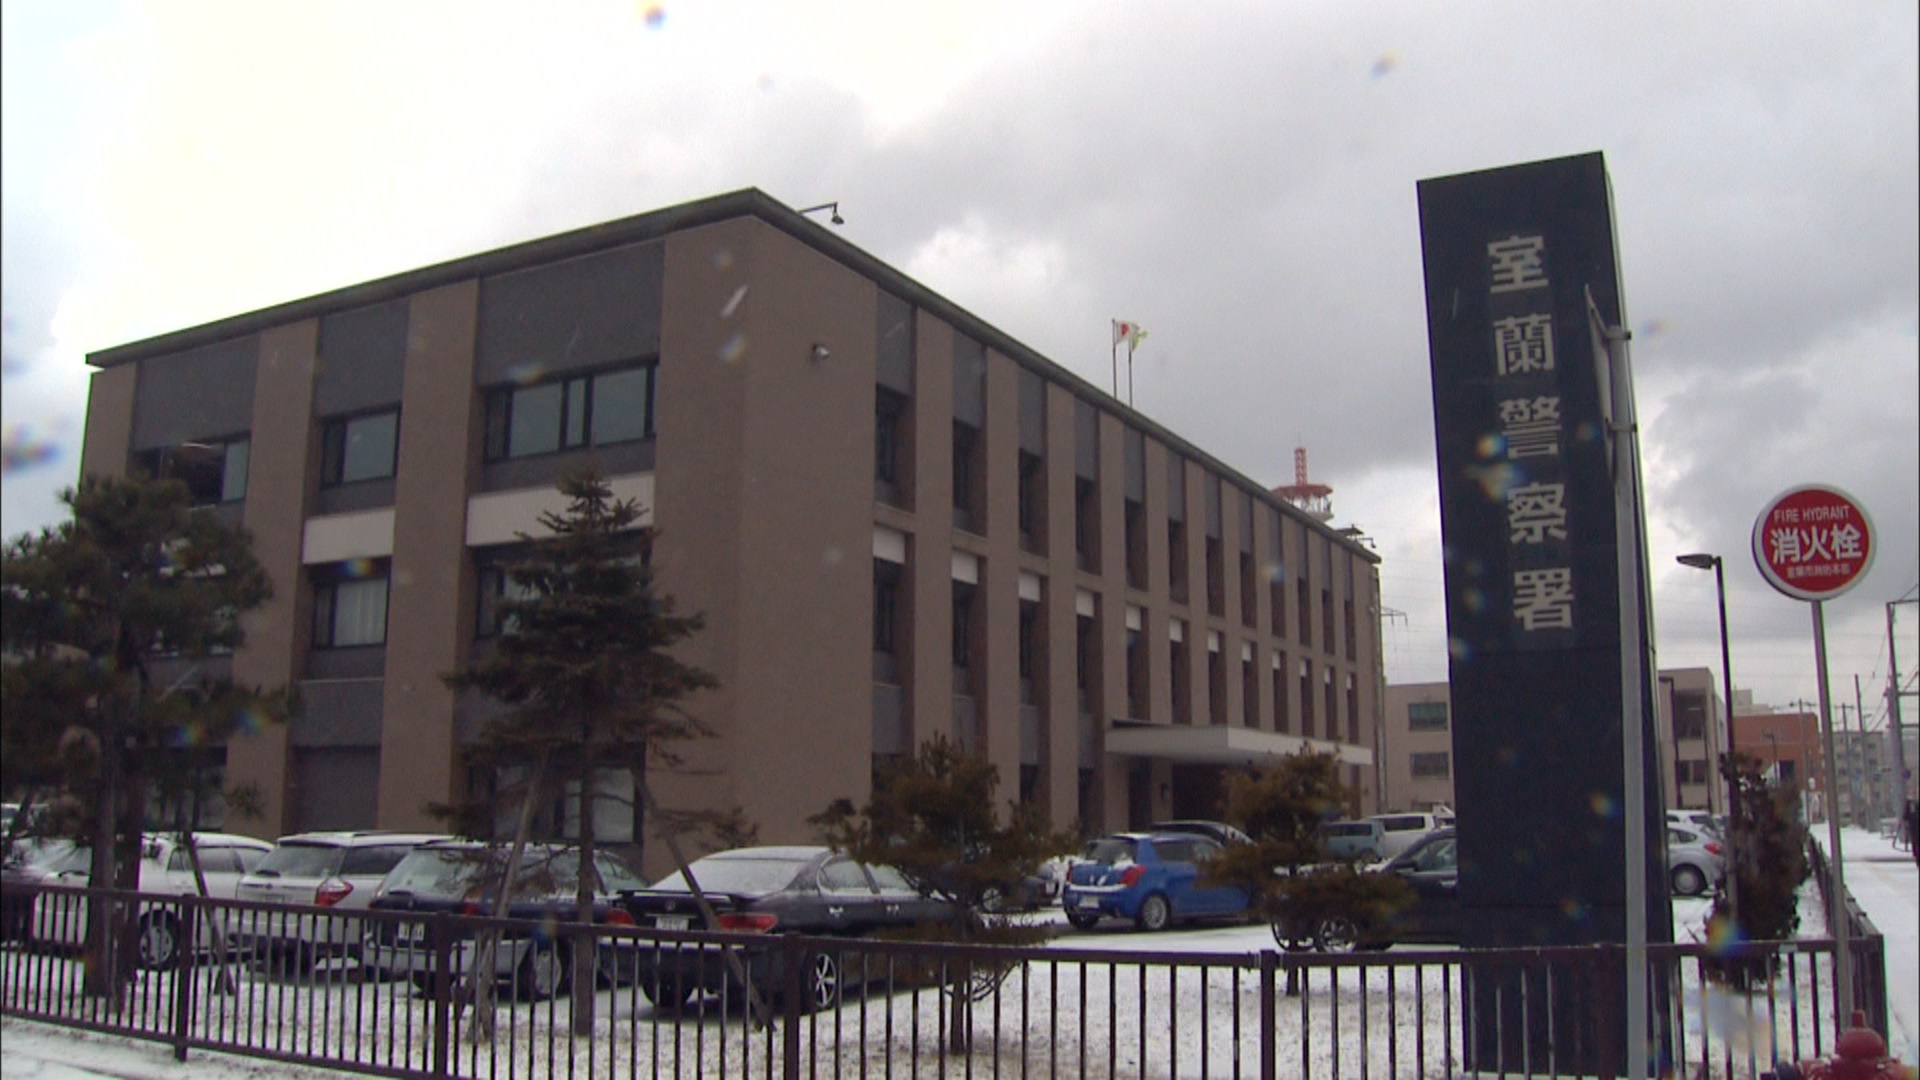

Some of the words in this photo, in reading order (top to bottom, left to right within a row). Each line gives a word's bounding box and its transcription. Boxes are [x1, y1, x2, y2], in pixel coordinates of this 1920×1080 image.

[1487, 235, 1575, 631] 室蘭警察署
[1774, 509, 1799, 523] FIRE
[1803, 505, 1850, 521] HYDRANT
[1770, 523, 1862, 564] 消火栓
